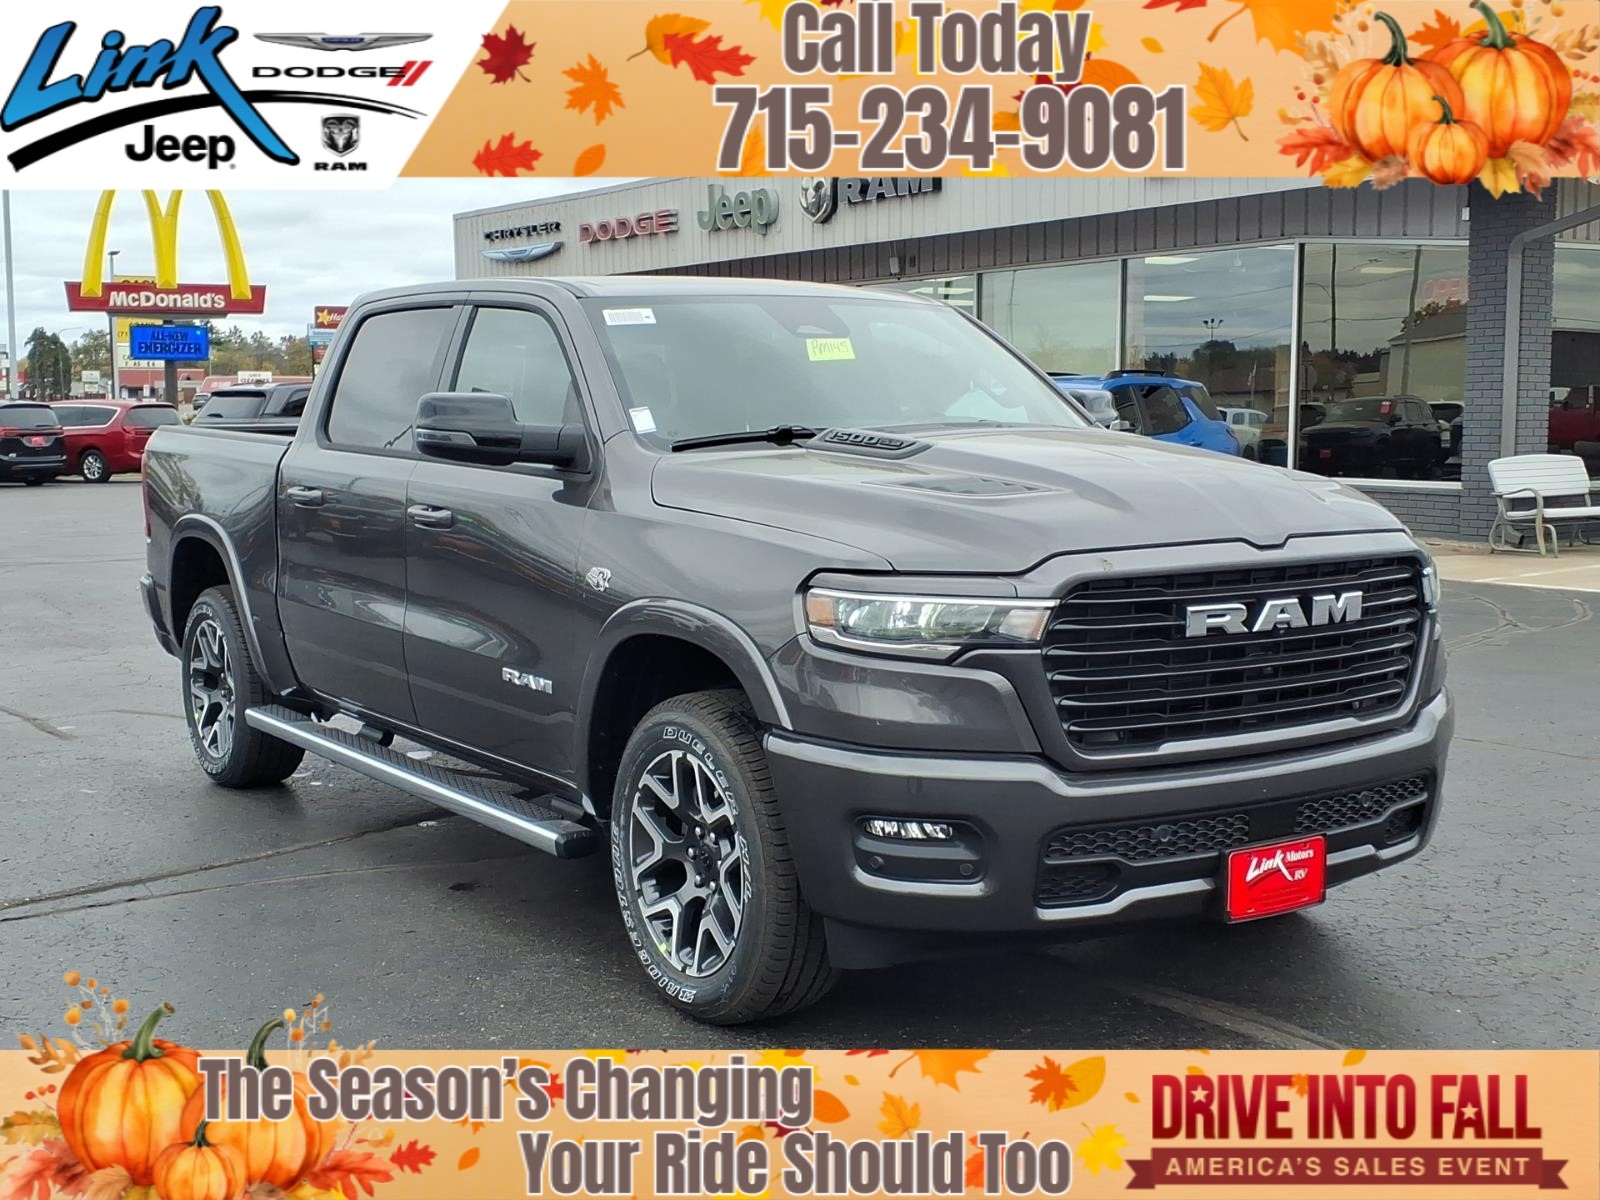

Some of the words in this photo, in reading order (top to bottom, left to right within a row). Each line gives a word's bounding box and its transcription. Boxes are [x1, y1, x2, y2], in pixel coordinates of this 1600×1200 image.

[838, 177, 941, 203] RAM
[697, 184, 780, 235] Jeep
[484, 221, 561, 242] CHRYSLER
[579, 209, 679, 243] DODGE
[109, 290, 226, 309] McDonald's
[829, 431, 880, 446] 1500
[1185, 591, 1363, 638] RAM
[502, 667, 553, 694] RAM
[663, 726, 739, 816] DUELER
[1245, 850, 1294, 882] Link
[1286, 849, 1314, 863] Motors
[1294, 867, 1309, 880] RV
